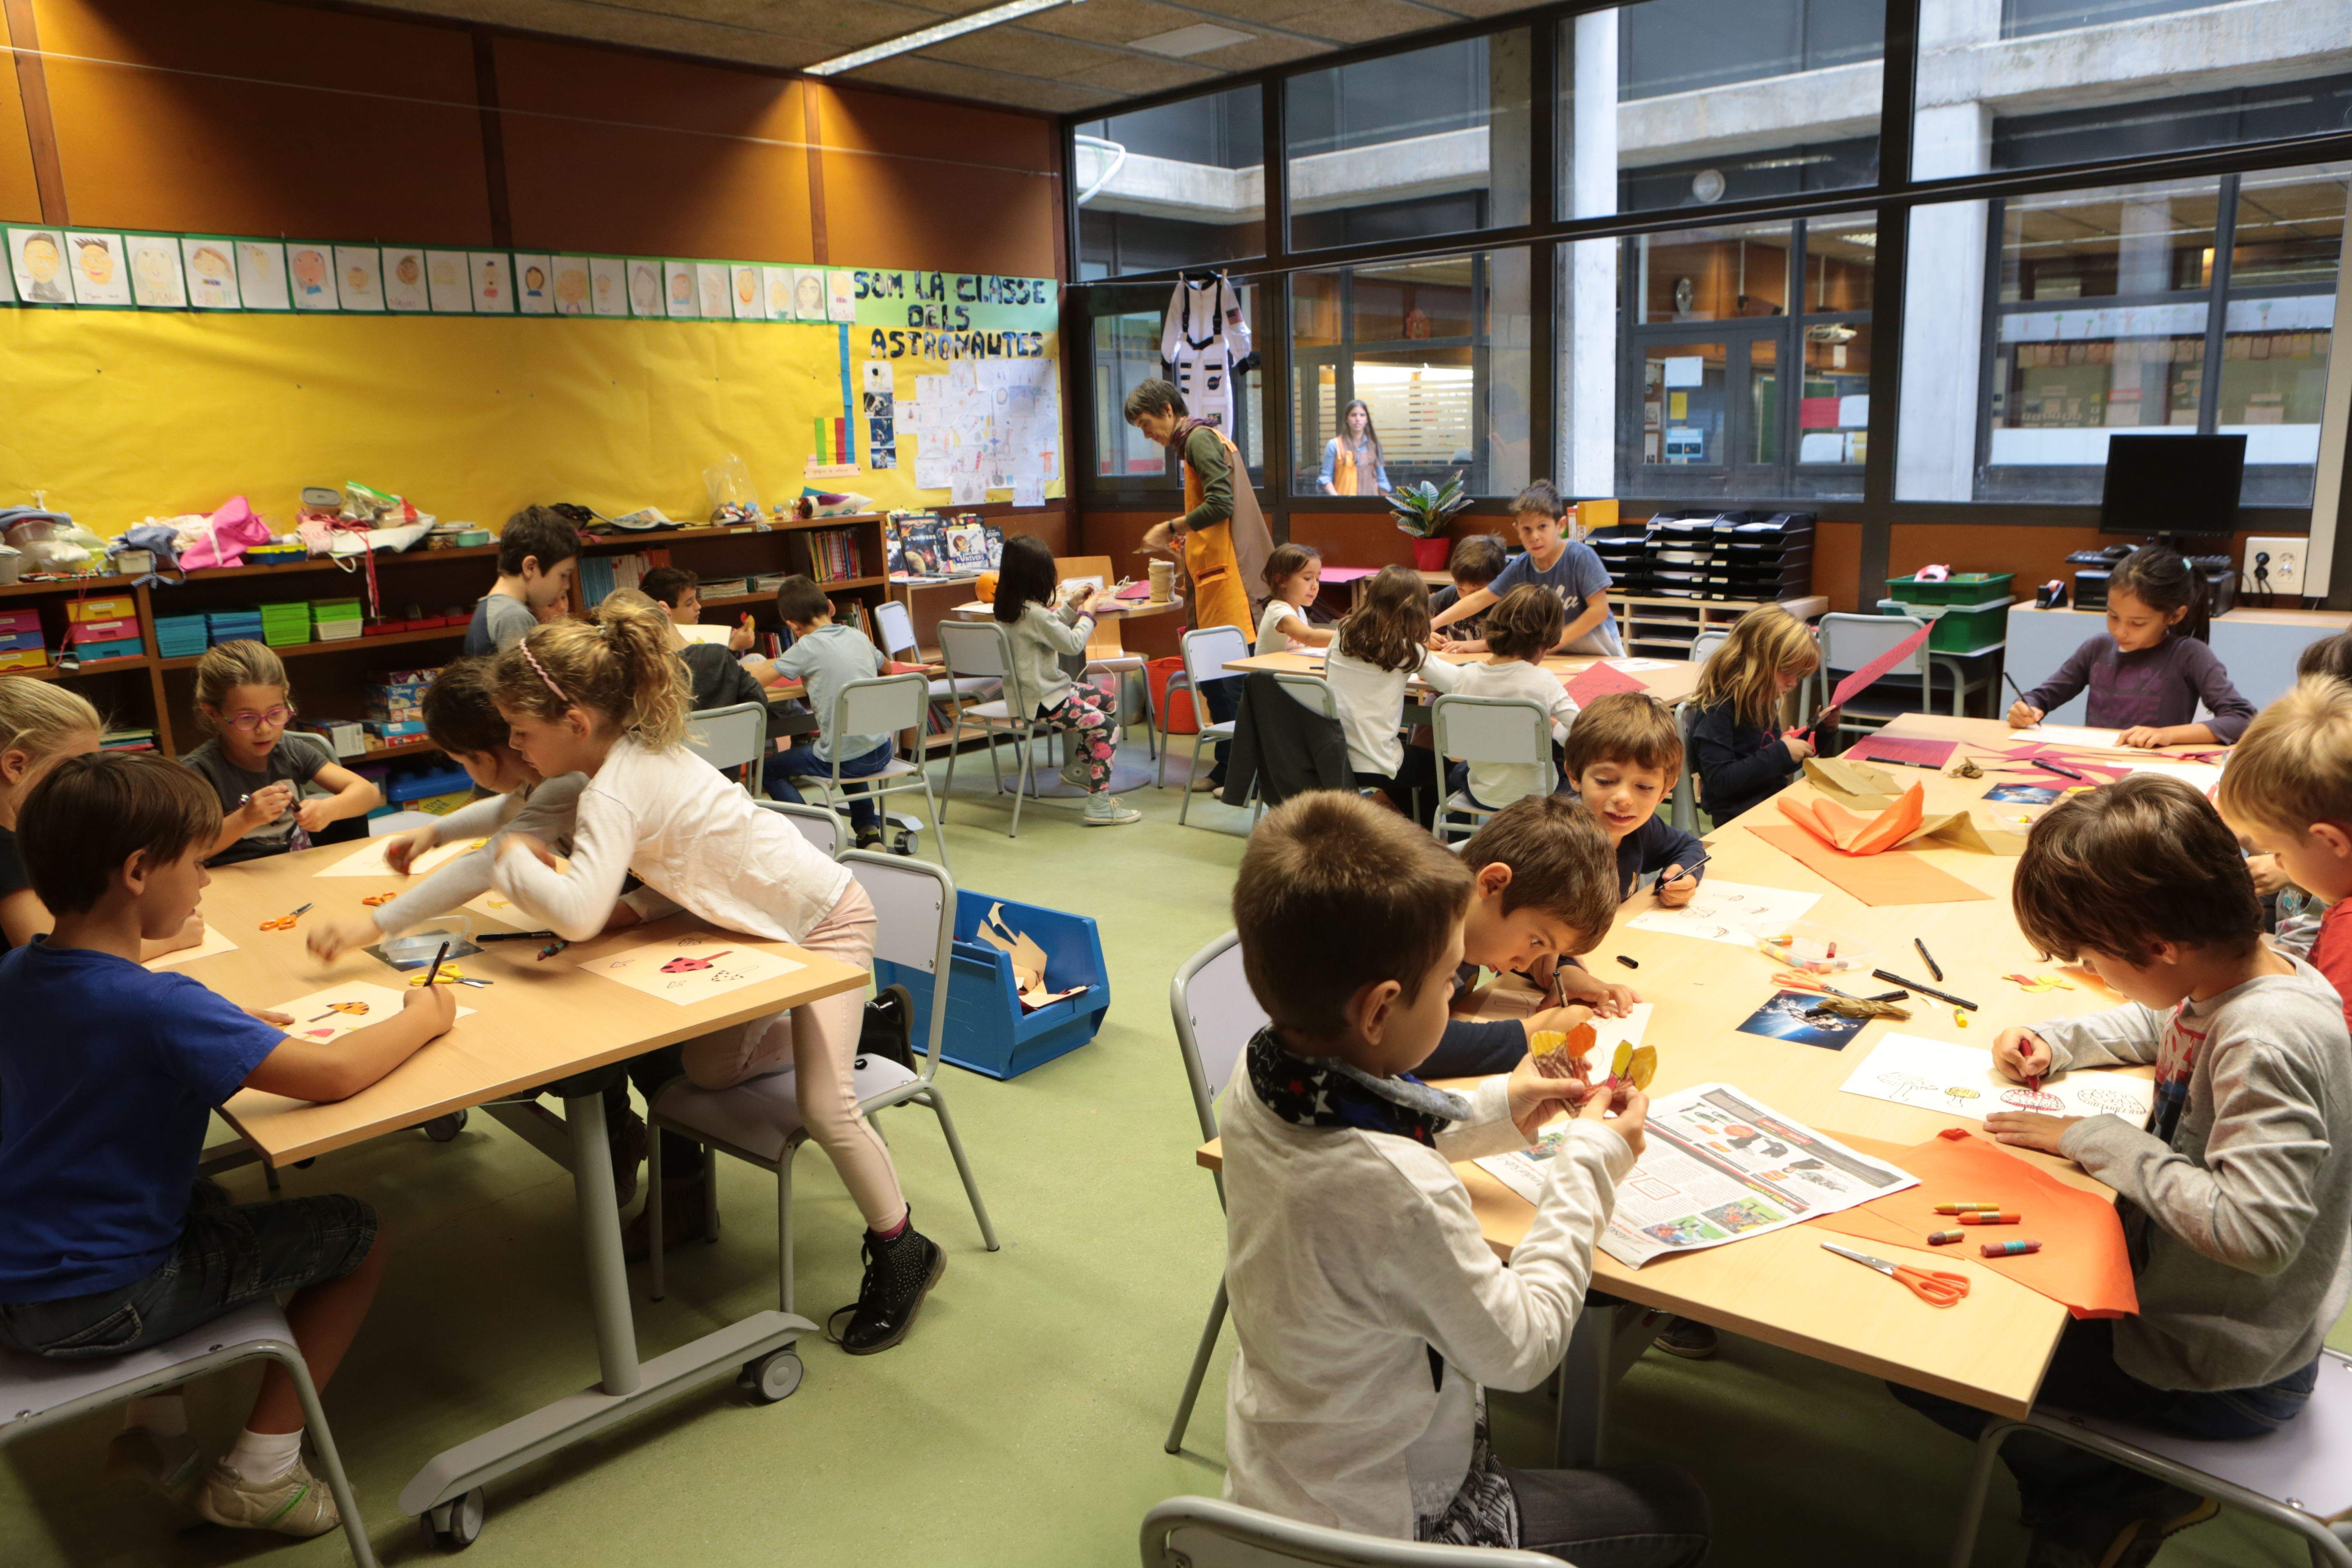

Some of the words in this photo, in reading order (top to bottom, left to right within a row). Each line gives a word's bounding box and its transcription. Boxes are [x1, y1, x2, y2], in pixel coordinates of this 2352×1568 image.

[854, 271, 904, 299] SOM
[915, 270, 945, 302] LA
[957, 274, 1047, 305] CLASSE
[908, 304, 970, 332] DELS
[871, 329, 1044, 360] ASTRONAUTES
